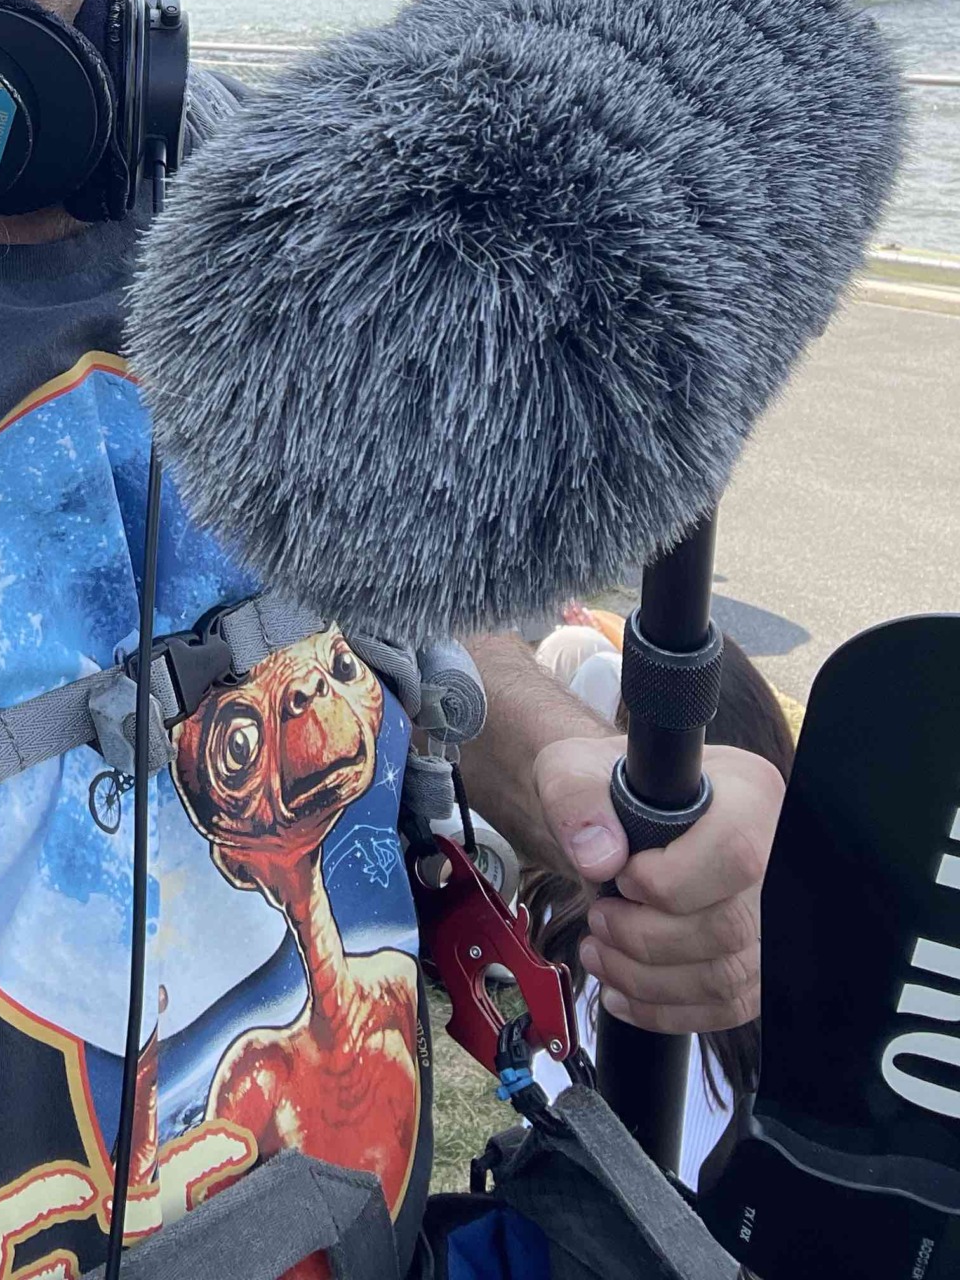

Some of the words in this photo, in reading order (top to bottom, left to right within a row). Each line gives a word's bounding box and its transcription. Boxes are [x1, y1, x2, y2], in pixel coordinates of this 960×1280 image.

[417, 1036, 429, 1057] UCS
[745, 1206, 756, 1222] TX
[740, 1224, 752, 1243] RX
